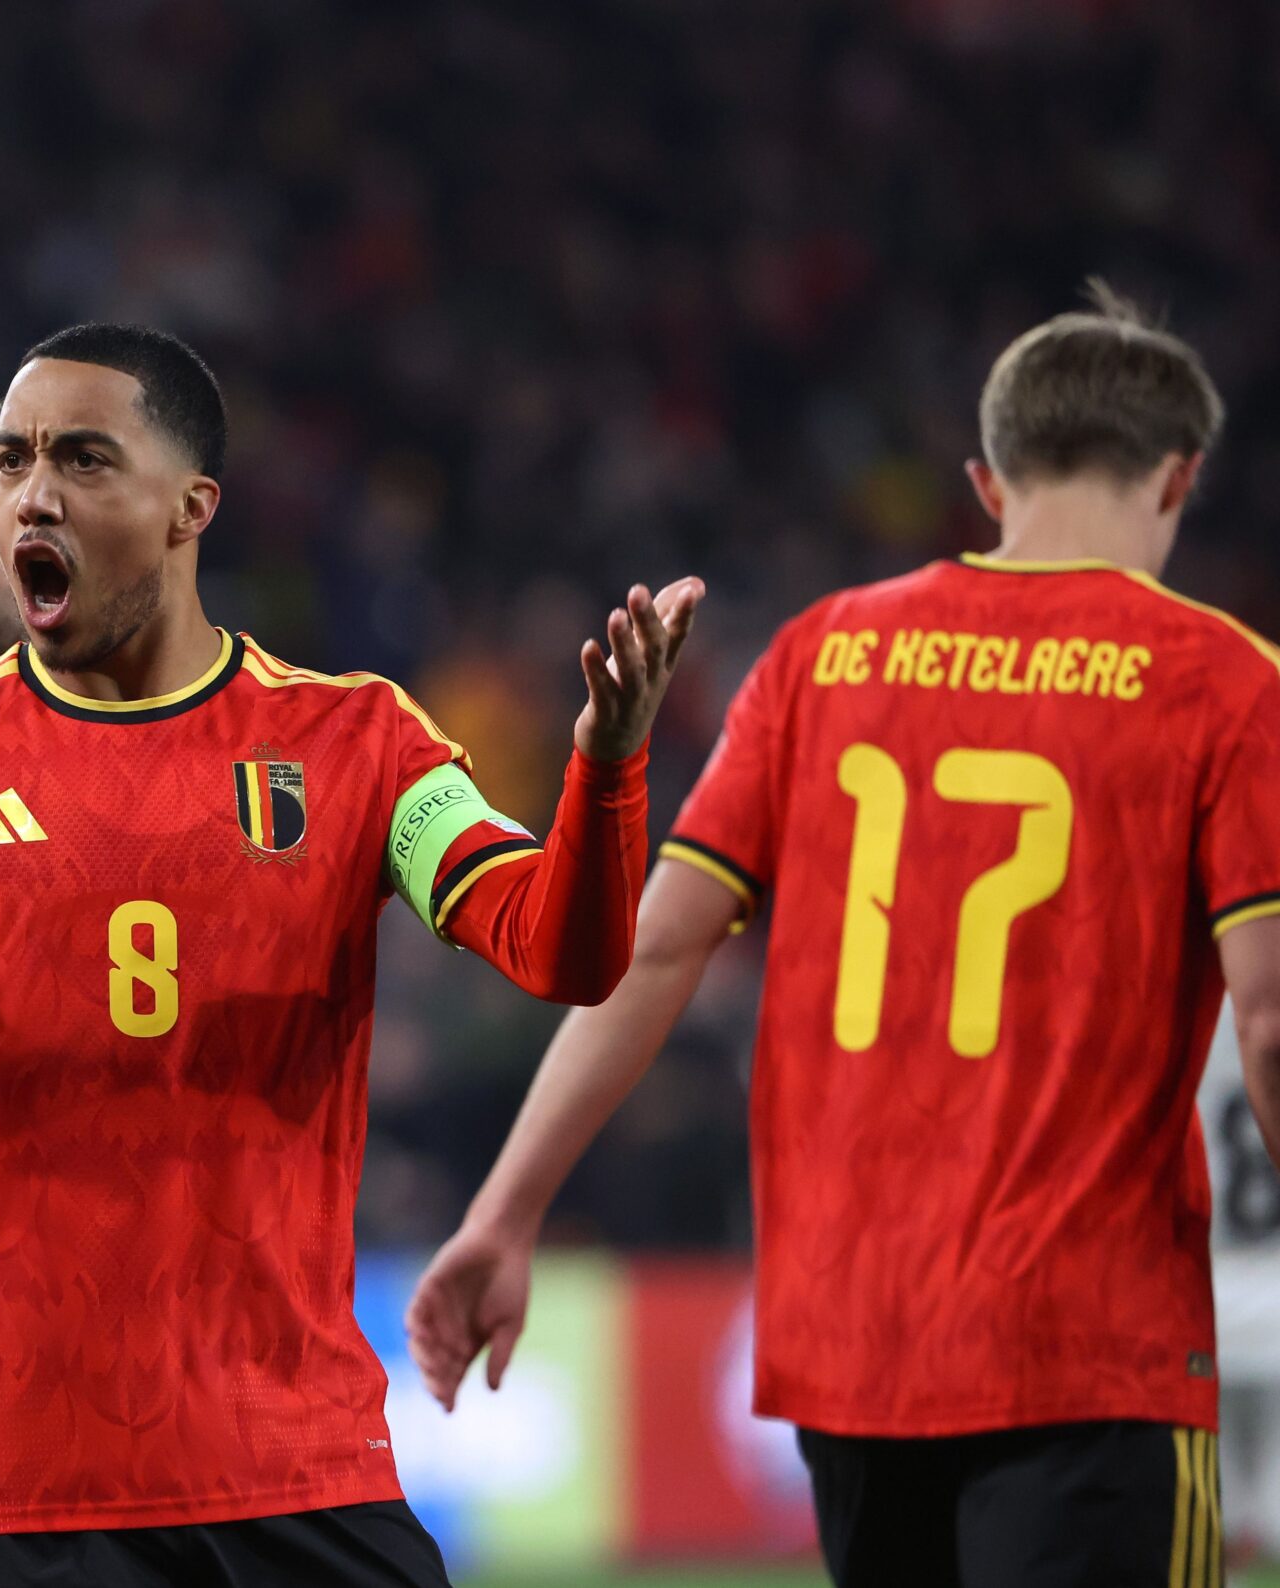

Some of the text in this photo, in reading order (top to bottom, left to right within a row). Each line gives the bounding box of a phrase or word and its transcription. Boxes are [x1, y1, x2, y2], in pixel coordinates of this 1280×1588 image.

[812, 629, 1152, 701] DE KETELAERE
[269, 764, 293, 772] ROYAL
[269, 771, 302, 780] BELGIAN
[834, 743, 1073, 1059] 17
[108, 899, 179, 1039] 8
